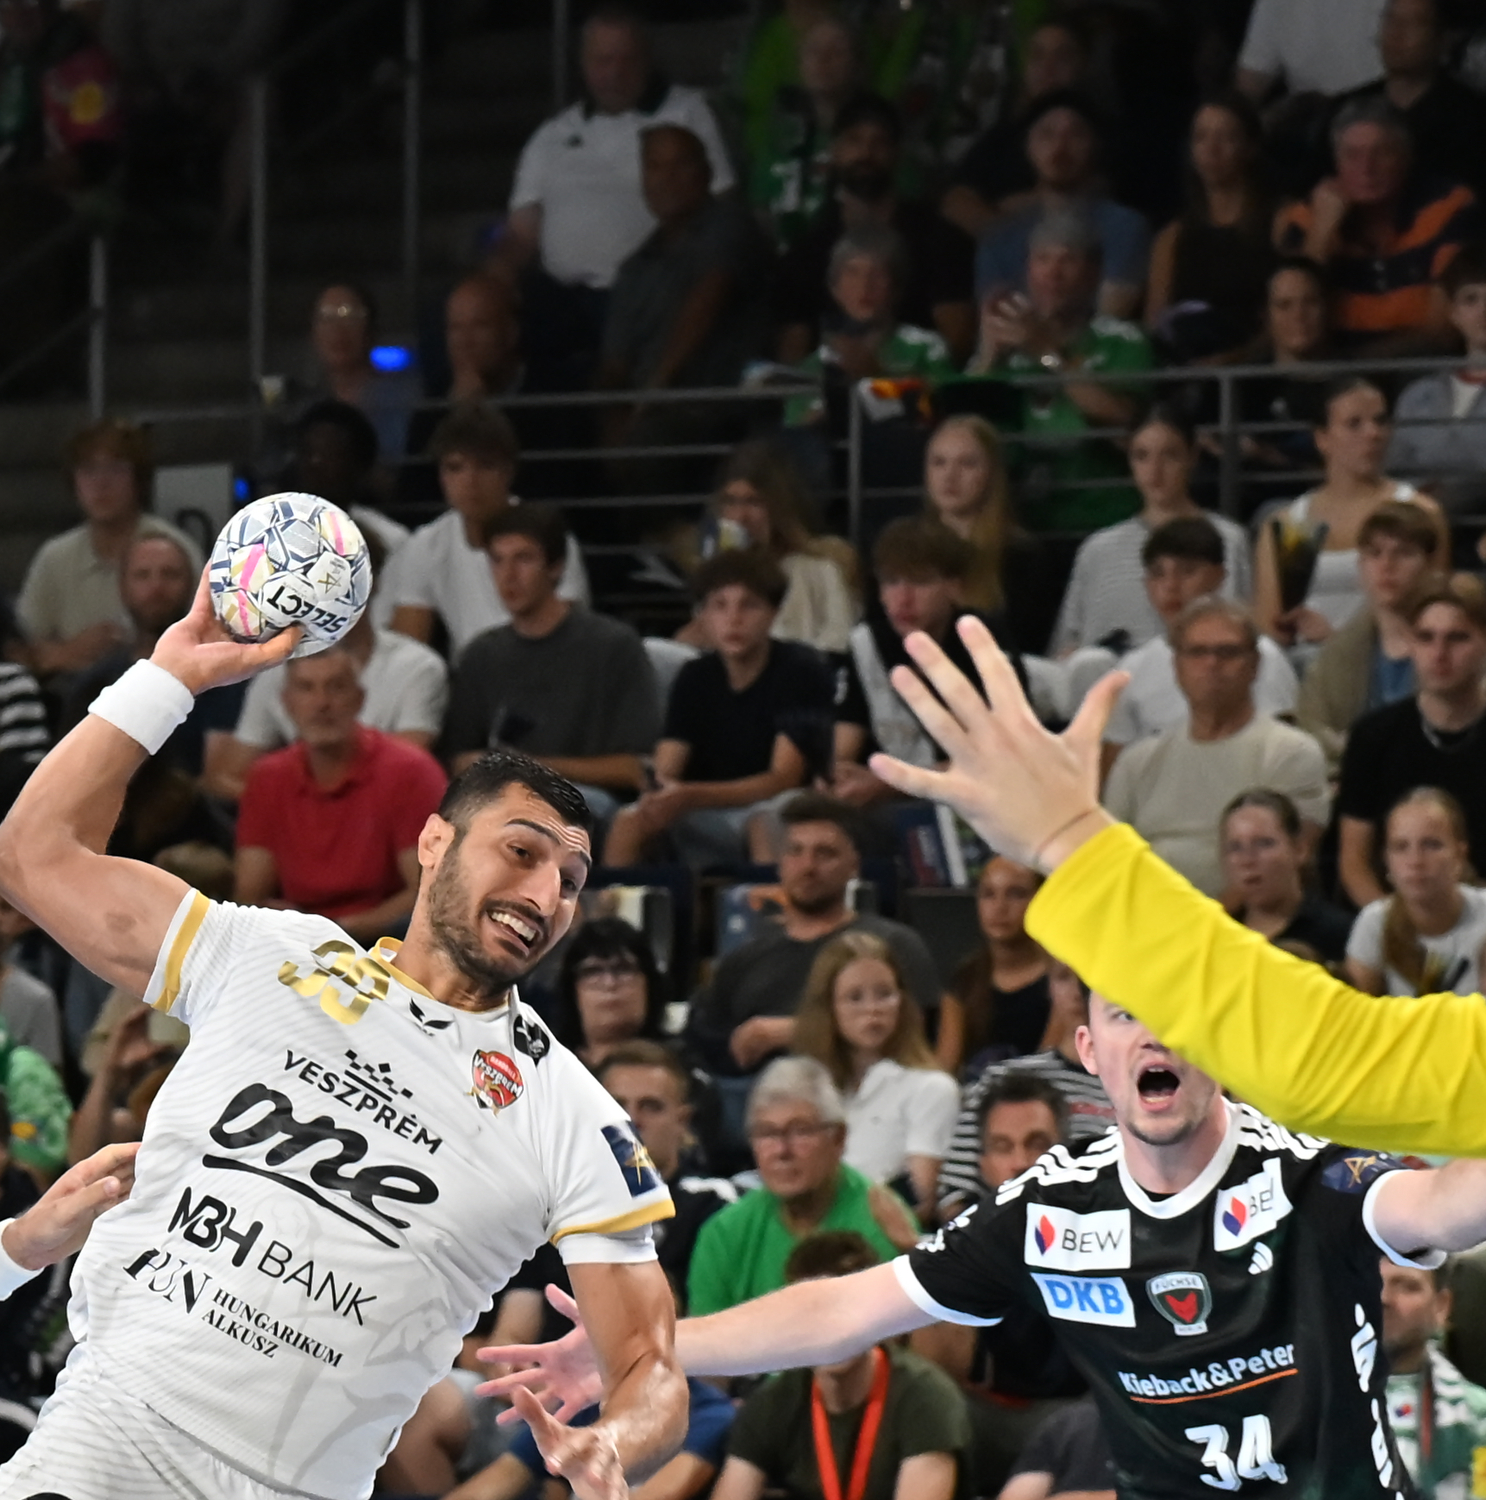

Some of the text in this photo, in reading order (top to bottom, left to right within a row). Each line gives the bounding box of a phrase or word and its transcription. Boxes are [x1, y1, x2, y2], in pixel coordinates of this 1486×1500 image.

[267, 585, 349, 634] SELECT
[284, 1049, 443, 1155] VESZPRÉM
[209, 1083, 440, 1230] one
[1061, 1228, 1124, 1254] BEW
[257, 1240, 377, 1326] BANK
[1045, 1279, 1125, 1315] DKB
[202, 1309, 281, 1359] ALKUSZ
[212, 1288, 345, 1368] HUNGARIKUM
[1117, 1343, 1294, 1397] Kieback&Peter
[1184, 1413, 1289, 1493] 34
